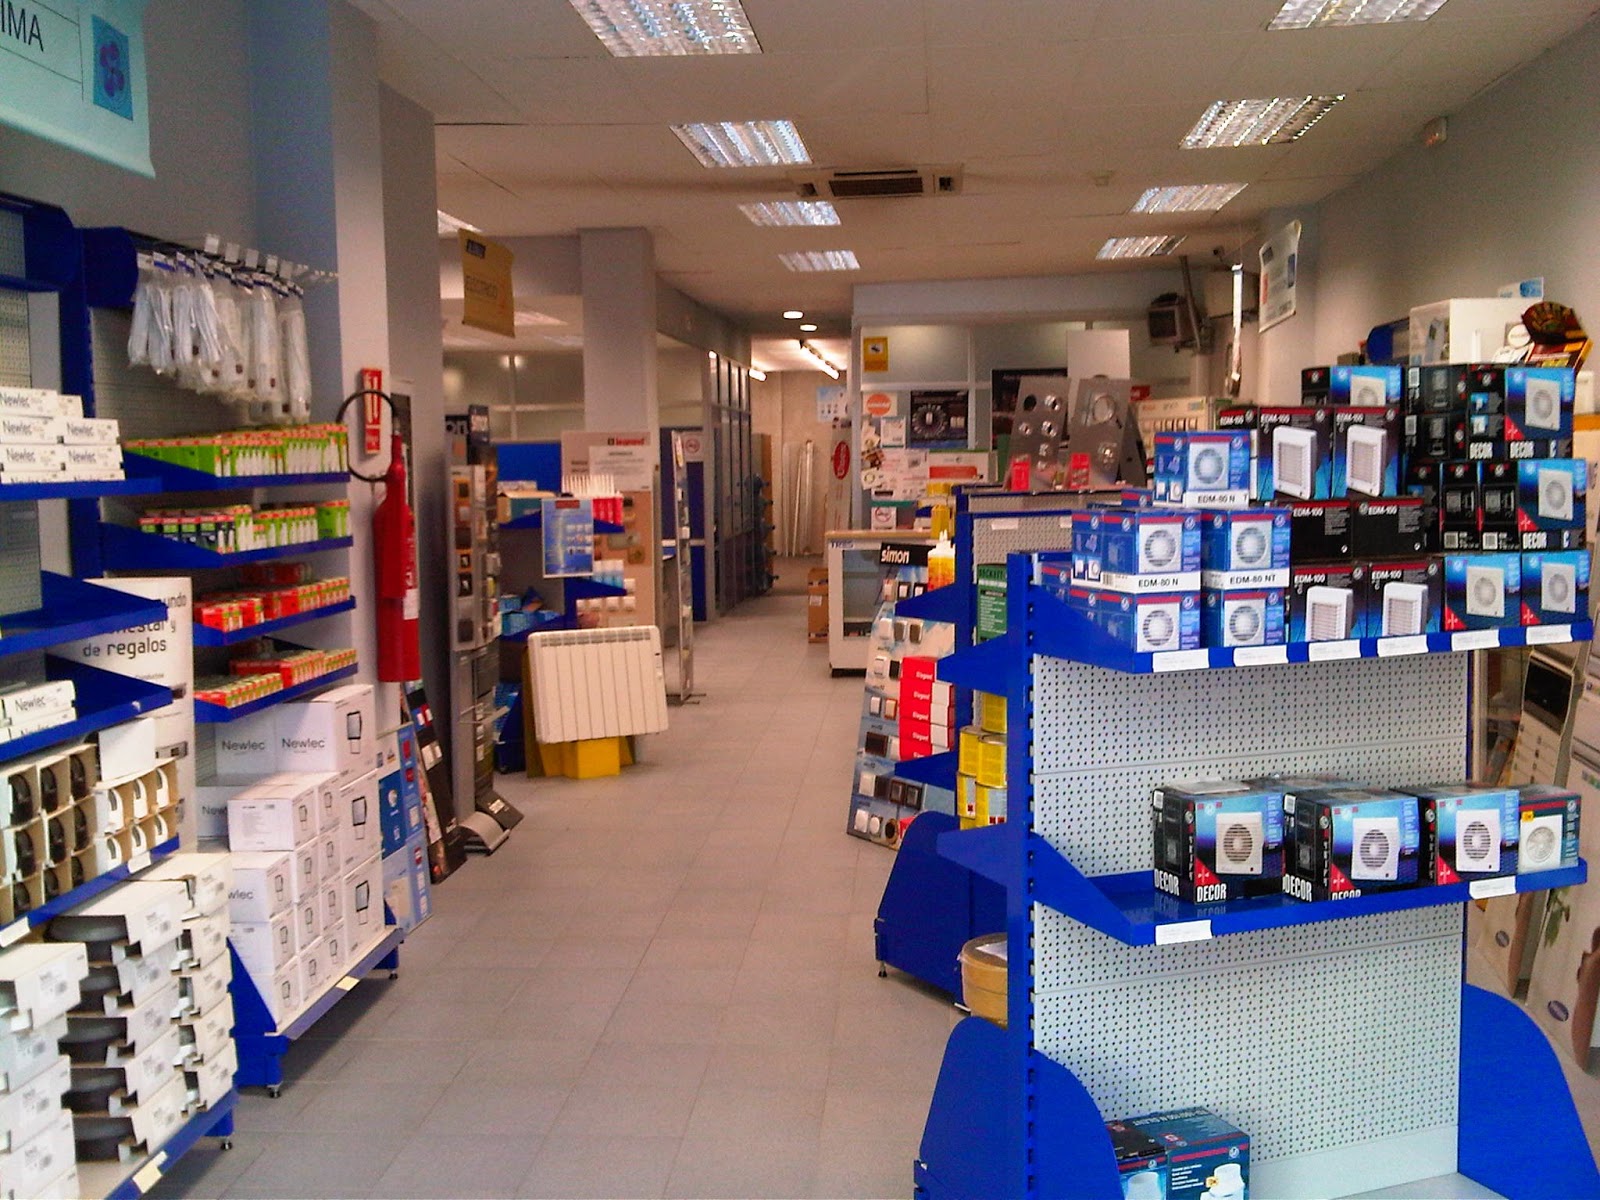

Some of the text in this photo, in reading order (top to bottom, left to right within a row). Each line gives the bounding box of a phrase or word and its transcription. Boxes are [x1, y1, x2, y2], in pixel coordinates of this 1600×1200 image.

[1470, 441, 1493, 459] DECOR
[1510, 440, 1534, 458] DECOR
[1523, 531, 1547, 550] DECOR
[880, 545, 910, 565] simon
[1138, 578, 1179, 588] EDM-80 N
[83, 637, 167, 660] de regalos
[15, 695, 46, 712] Newlec
[222, 740, 266, 752] Newlec
[281, 737, 326, 749] Newlec
[1154, 868, 1180, 897] DECOR
[1284, 873, 1313, 902] DECOR
[1197, 882, 1227, 902] DECOR
